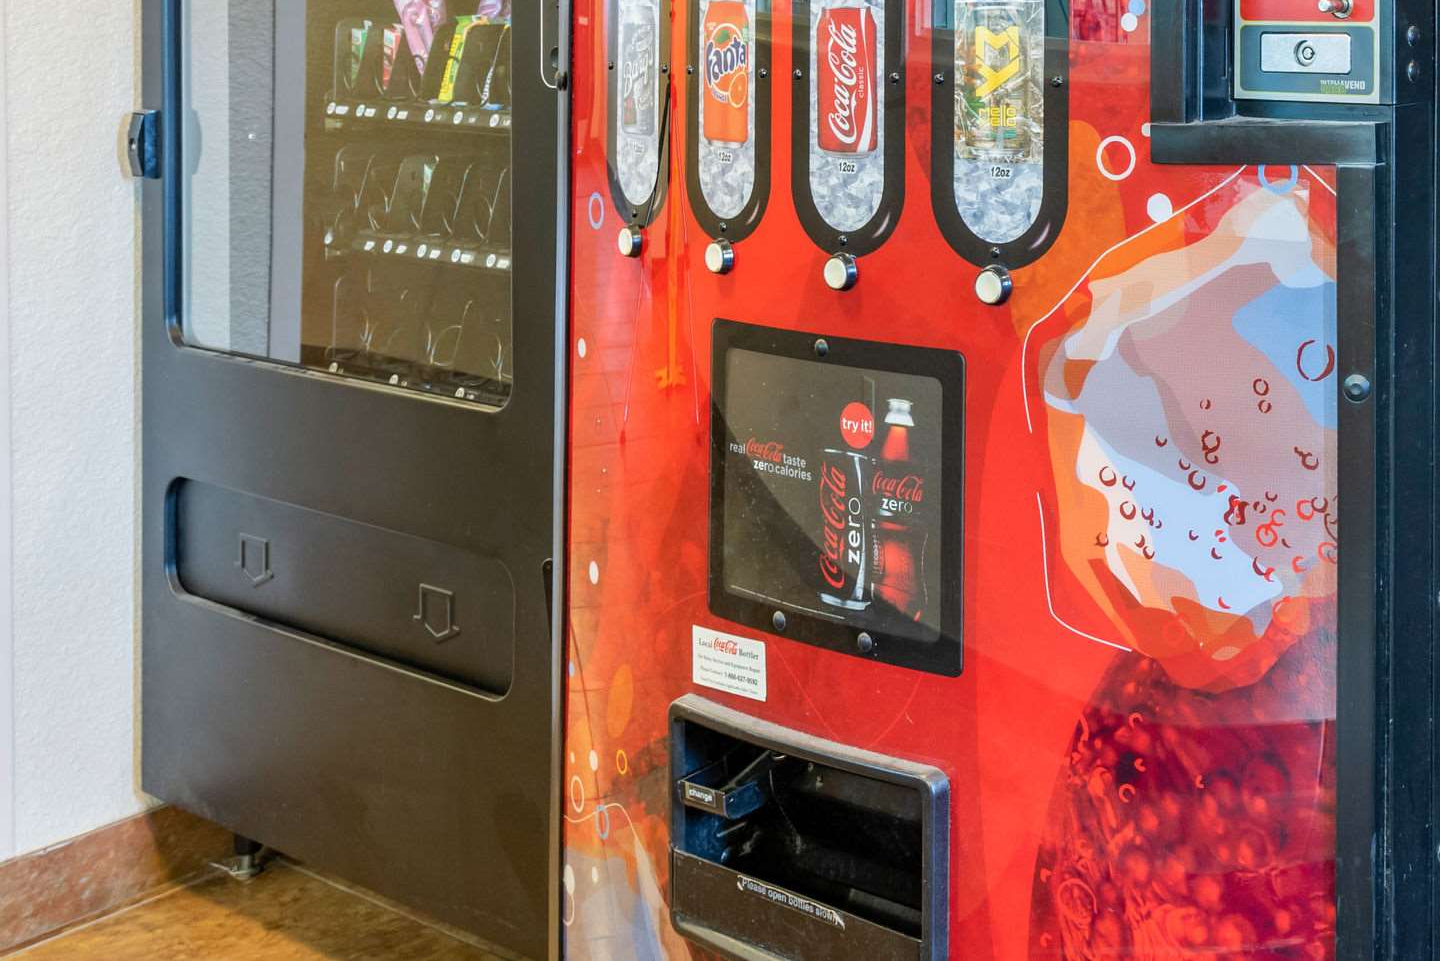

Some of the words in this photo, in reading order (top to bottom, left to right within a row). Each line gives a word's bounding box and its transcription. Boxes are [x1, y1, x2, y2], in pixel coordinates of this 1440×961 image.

[706, 35, 747, 88] Fanta
[827, 18, 858, 144] Coca-Cola
[839, 162, 856, 173] 12oz
[990, 167, 1011, 178] 12oz
[842, 417, 859, 432] try
[861, 420, 873, 433] it!
[730, 442, 746, 455] real
[783, 453, 806, 469] taste
[753, 459, 775, 473] zero
[775, 464, 812, 481] calories
[882, 498, 913, 513] zero
[848, 497, 861, 565] zero
[767, 890, 787, 903] open
